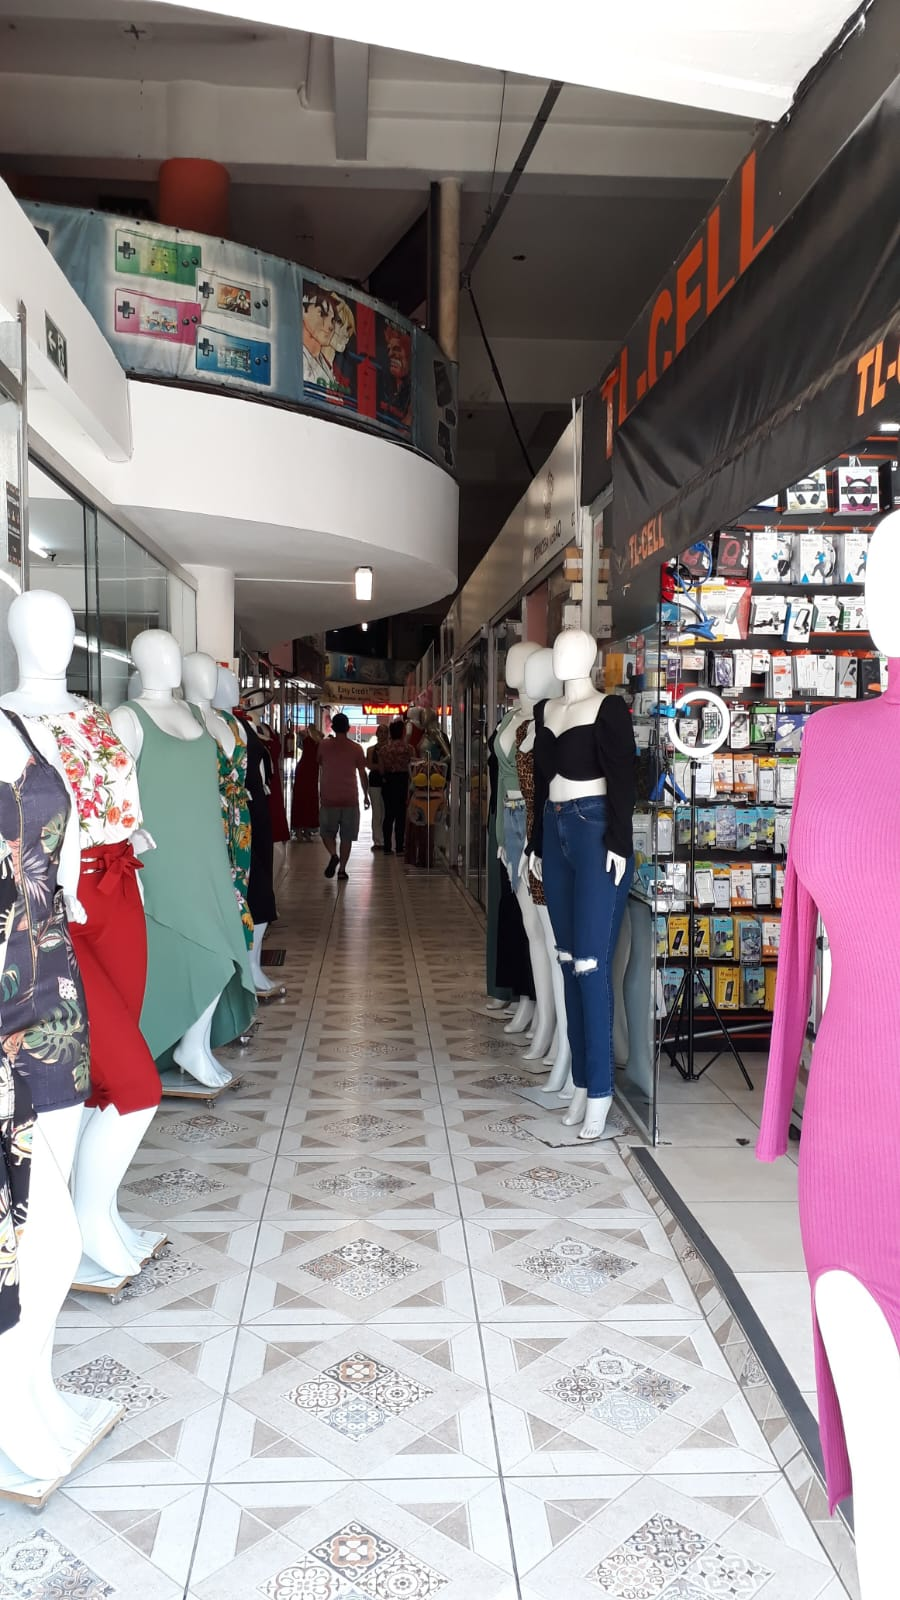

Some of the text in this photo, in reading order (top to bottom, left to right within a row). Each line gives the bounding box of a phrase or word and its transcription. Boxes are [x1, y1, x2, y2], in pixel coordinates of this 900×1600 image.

[857, 340, 900, 416] TL-
[629, 511, 665, 568] TL-CELL
[351, 687, 369, 695] Credit
[364, 704, 400, 714] Vendas
